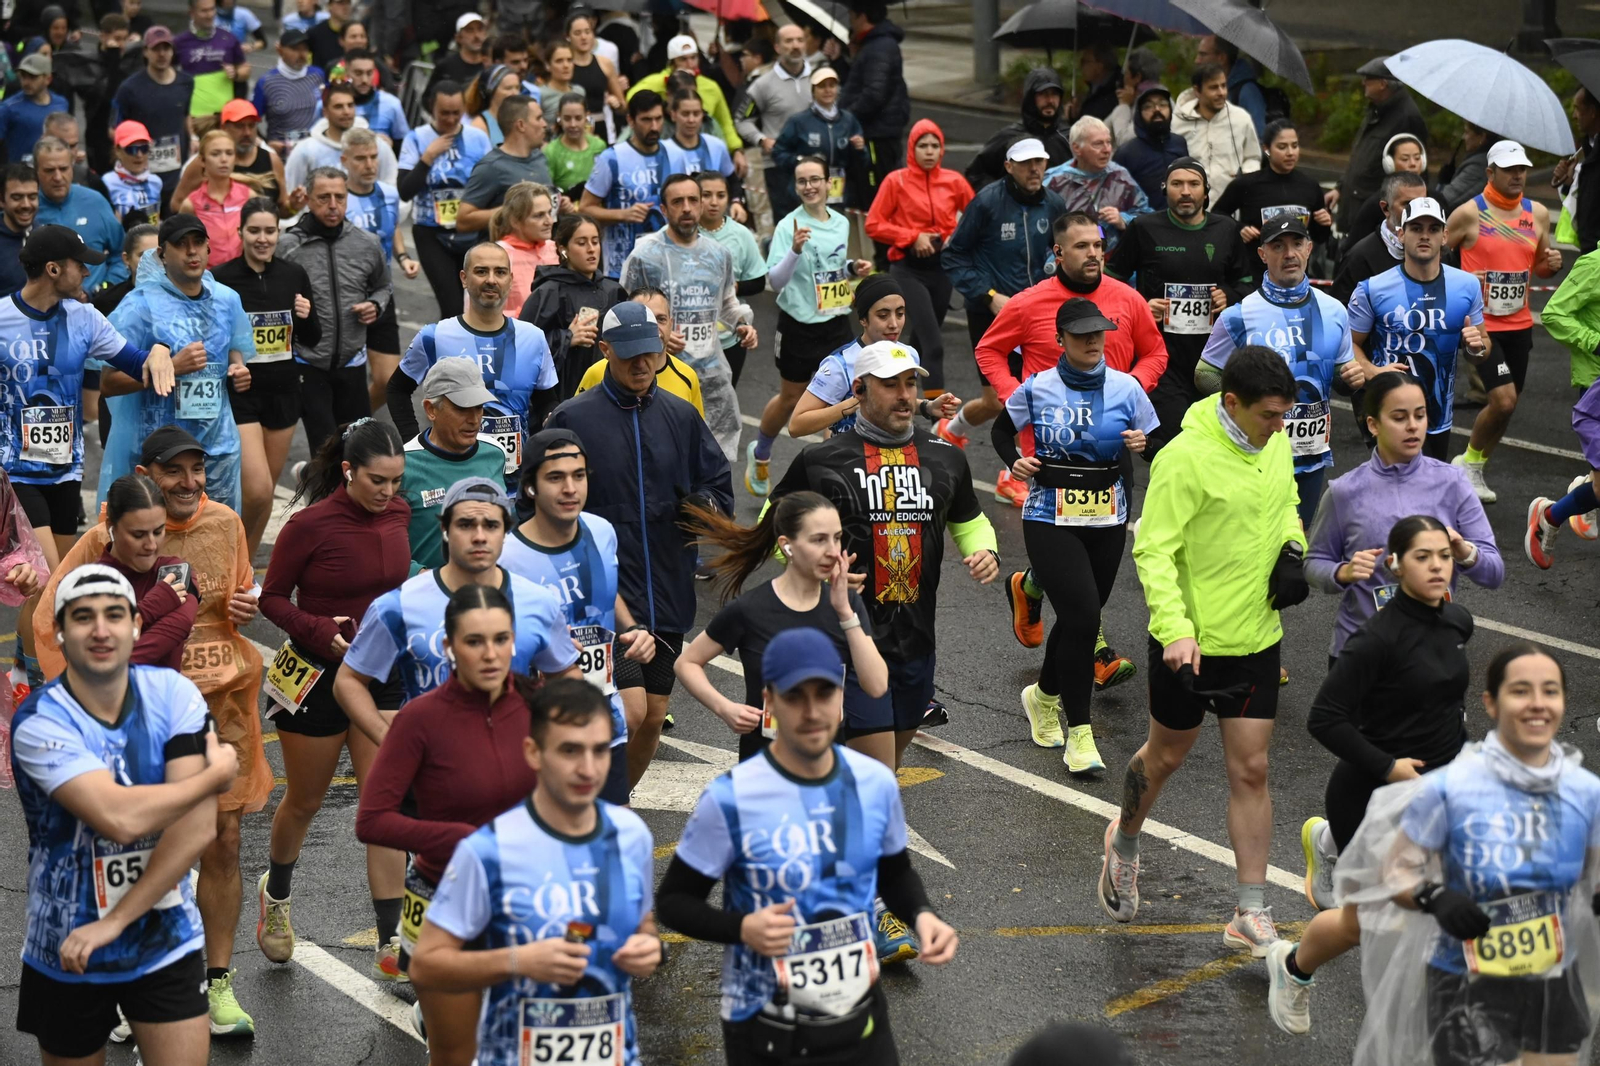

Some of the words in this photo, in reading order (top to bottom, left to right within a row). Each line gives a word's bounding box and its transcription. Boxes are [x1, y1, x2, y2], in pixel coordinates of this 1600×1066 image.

[618, 165, 659, 187] CÓR
[440, 201, 461, 215] 73
[681, 286, 710, 295] MEDIA
[1490, 286, 1525, 300] 5839
[1171, 301, 1210, 316] 7483
[1383, 302, 1447, 331] CÓR
[253, 327, 286, 345] 504
[682, 325, 711, 341] 1595
[1247, 322, 1307, 351] CÓR
[1386, 331, 1426, 353] DO
[182, 382, 221, 399] 7431
[1040, 400, 1095, 426] CÓR
[30, 425, 70, 444] 6538
[1041, 426, 1075, 446] DO
[1286, 418, 1326, 438] 1602
[1064, 488, 1111, 504] 6315
[870, 513, 892, 522] XXIV
[896, 511, 933, 522] EDICIÓN
[182, 643, 233, 671] 2558
[575, 649, 606, 674] 98
[742, 813, 837, 860] CÓR
[501, 871, 600, 921] CÓR
[1477, 922, 1551, 961] 6891
[790, 950, 864, 990] 5317
[535, 1030, 613, 1062] 5278
